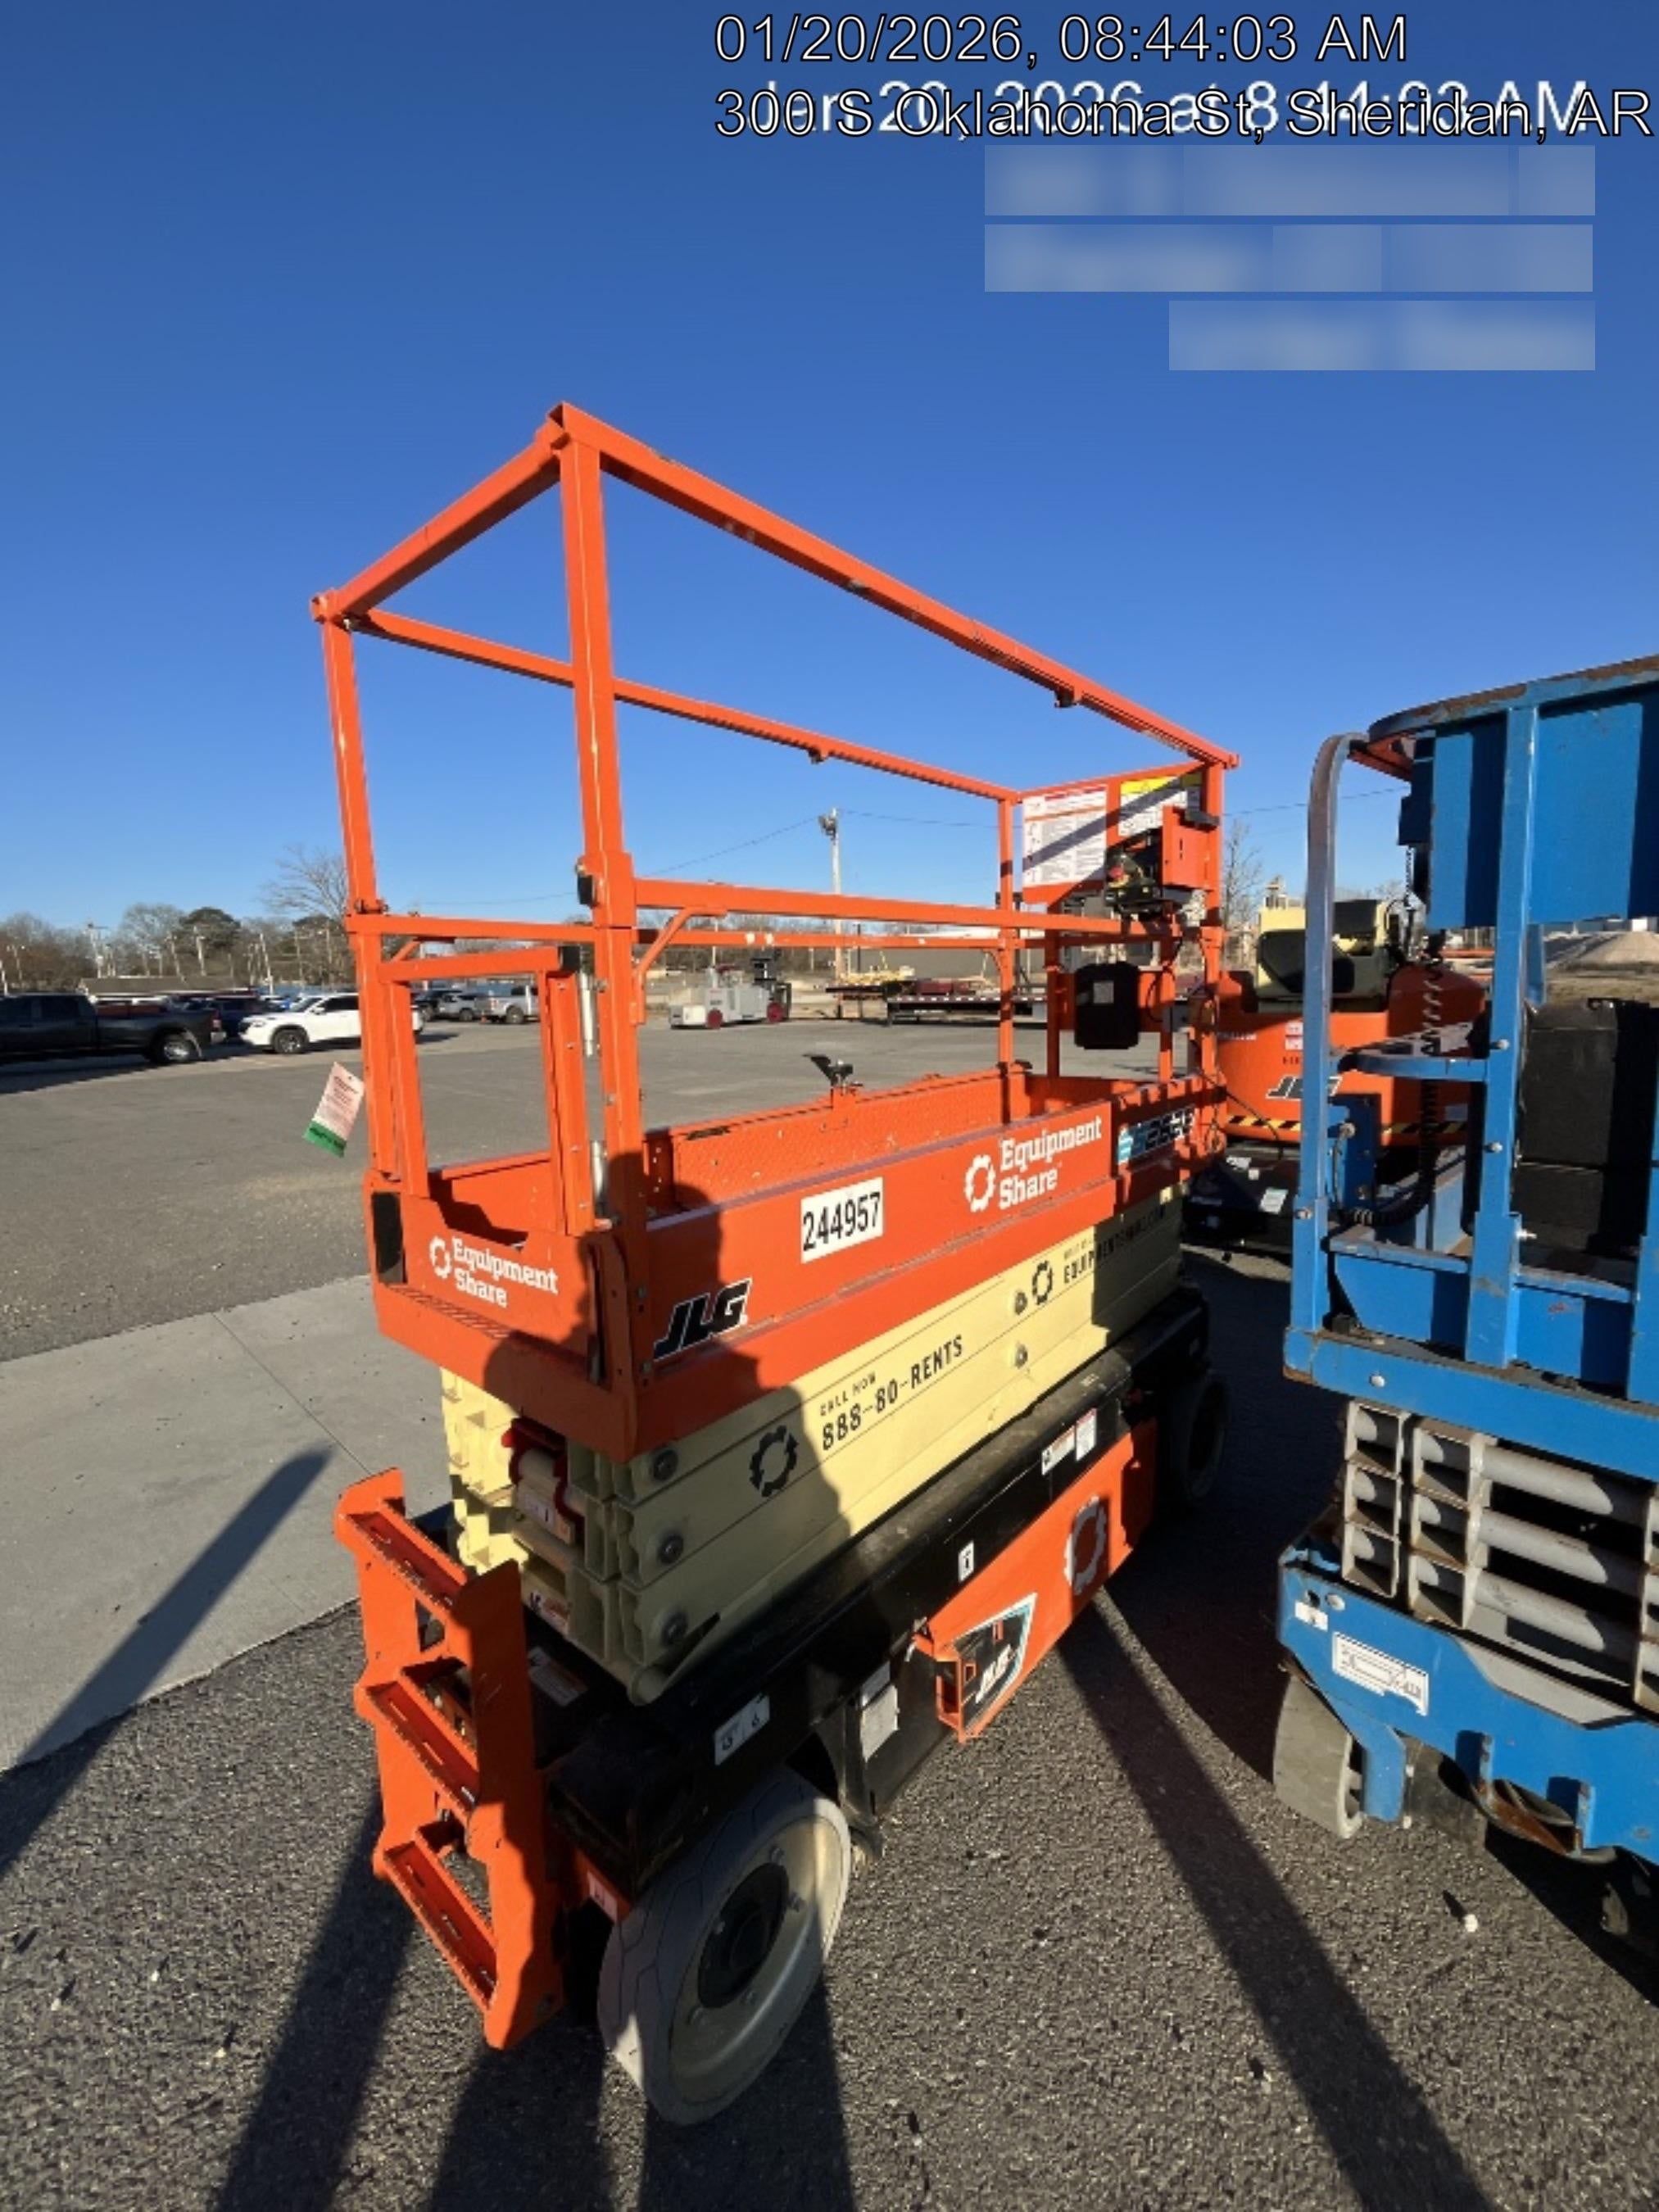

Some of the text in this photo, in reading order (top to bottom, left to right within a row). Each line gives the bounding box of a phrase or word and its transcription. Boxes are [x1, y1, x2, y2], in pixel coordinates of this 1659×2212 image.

[999, 1115, 1102, 1173] Equipment
[999, 1167, 1058, 1210] Share
[803, 1190, 881, 1252] 244957
[452, 1237, 559, 1295] Equipment
[455, 1267, 507, 1308] Share
[653, 1277, 753, 1362] JLG
[820, 1371, 877, 1416] CALL NOW
[823, 1334, 963, 1451] 888-80-RENTS
